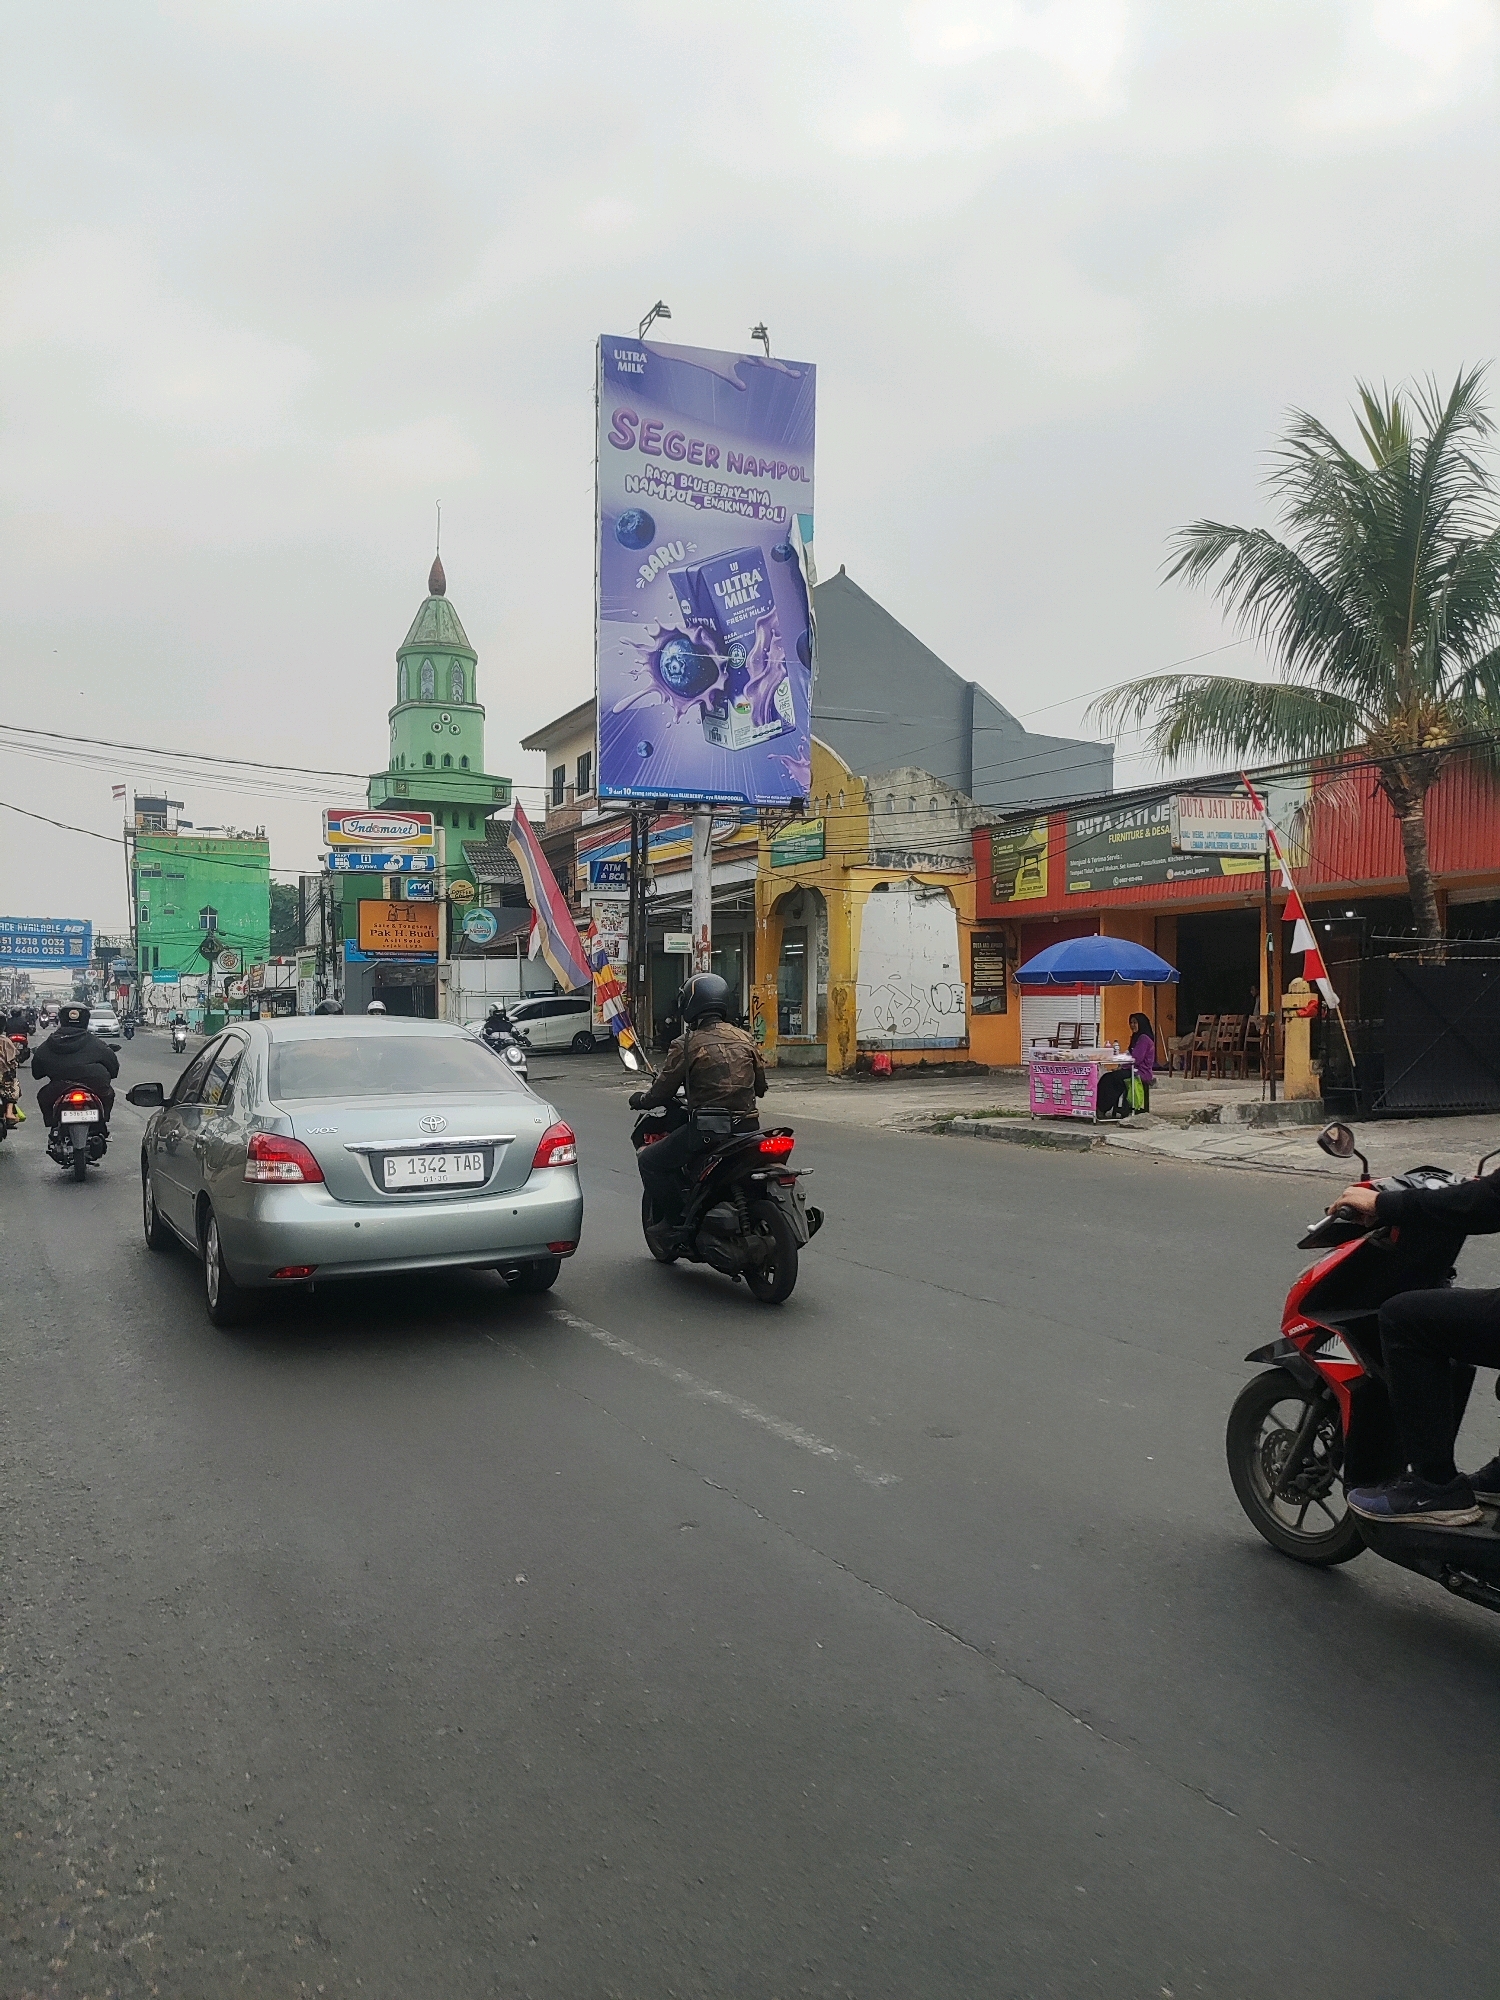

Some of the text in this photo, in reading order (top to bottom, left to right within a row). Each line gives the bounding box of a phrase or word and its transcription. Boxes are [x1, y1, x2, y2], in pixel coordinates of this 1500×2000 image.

[614, 349, 648, 363] ULTRA
[617, 361, 645, 374] MILK
[608, 407, 811, 483] SEGER NAMPOL
[645, 463, 675, 486] RASA
[703, 496, 754, 518] ENAKNYA
[758, 505, 787, 524] POL!
[639, 540, 686, 582] BARU
[714, 569, 763, 597] ULTRA
[724, 584, 761, 610] MILK
[726, 606, 766, 626] FRESH MILK
[623, 787, 632, 795] 10
[1181, 798, 1205, 818] DUTA
[1207, 799, 1227, 819] JATI
[347, 820, 413, 834] Indomaret
[1076, 803, 1169, 837] DUTA JATI JE
[1108, 827, 1144, 844] FURNITURE
[1144, 827, 1151, 838] &
[1091, 855, 1107, 863] Terima
[603, 863, 622, 872] ATM
[608, 872, 625, 881] BCA
[17, 922, 61, 933] AVAILABLE
[370, 929, 391, 937] Pak
[15, 936, 38, 946] 8318
[41, 938, 65, 947] 0032
[0, 945, 65, 955] 22 4680 0353
[305, 1126, 339, 1135] VIOS
[386, 1154, 482, 1176] B 1342 TAB
[1287, 1322, 1309, 1336] HONDA
